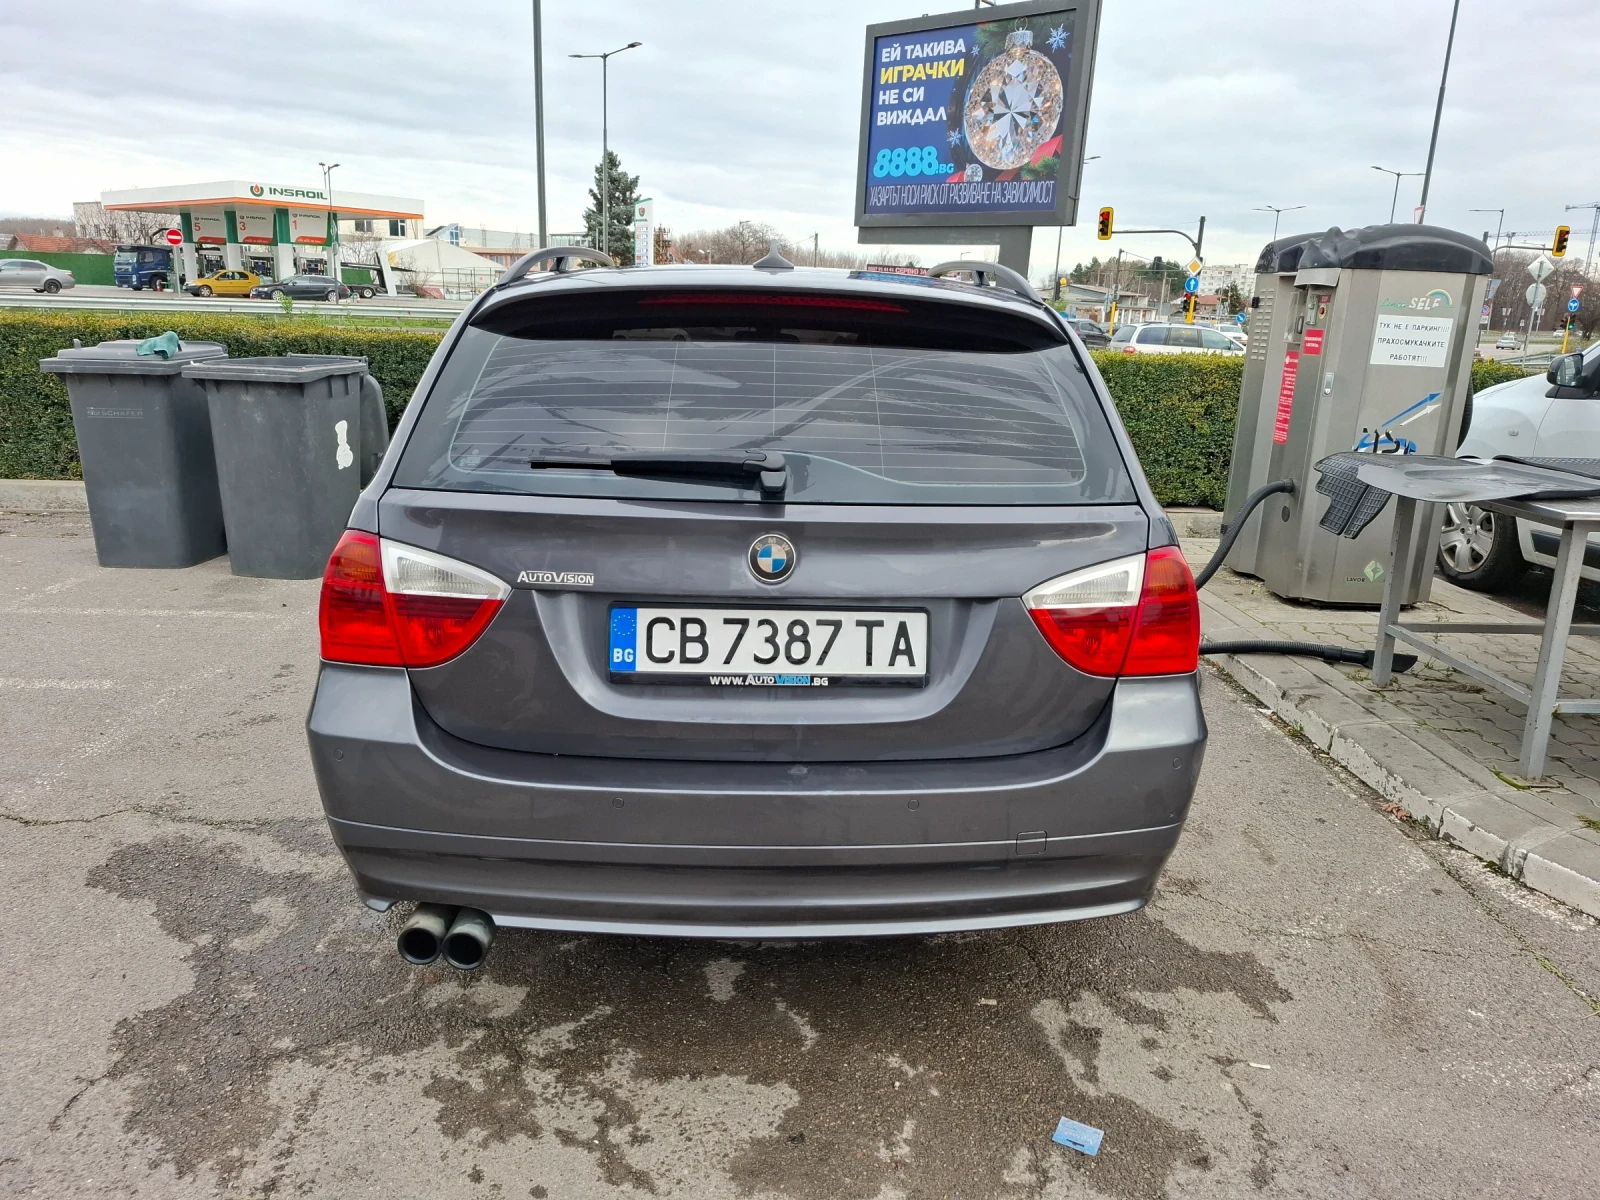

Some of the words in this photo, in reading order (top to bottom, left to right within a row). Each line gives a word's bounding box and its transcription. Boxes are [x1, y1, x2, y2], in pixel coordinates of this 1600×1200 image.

[881, 43, 901, 62] ЕЙ
[904, 38, 966, 60] ТАКИВА
[880, 58, 965, 85] ИГРАЧКИ
[878, 89, 900, 105] НЕ
[902, 86, 925, 103] СИ
[877, 106, 948, 126] ВИЖДАЛ
[269, 187, 328, 200] INSAOIL
[869, 184, 901, 206] ХАЗАРТЪТ
[902, 184, 920, 205] НОСИ
[920, 184, 939, 205] РИСК
[940, 183, 950, 204] ОТ
[950, 182, 991, 204] РАЗВИВАНЕ
[991, 182, 1001, 203] НА
[1001, 180, 1055, 203] ЗАВИСИМОСТ
[194, 222, 201, 231] 5
[239, 221, 247, 231] 3
[292, 220, 298, 230] 1
[1408, 297, 1441, 310] SELF
[1377, 337, 1445, 348] ПРАХОСМУКАЧКИТЕ
[754, 537, 791, 551] BMW
[645, 616, 710, 665] CB
[722, 617, 843, 666] 7387
[855, 619, 916, 667] TA
[613, 648, 634, 663] BG
